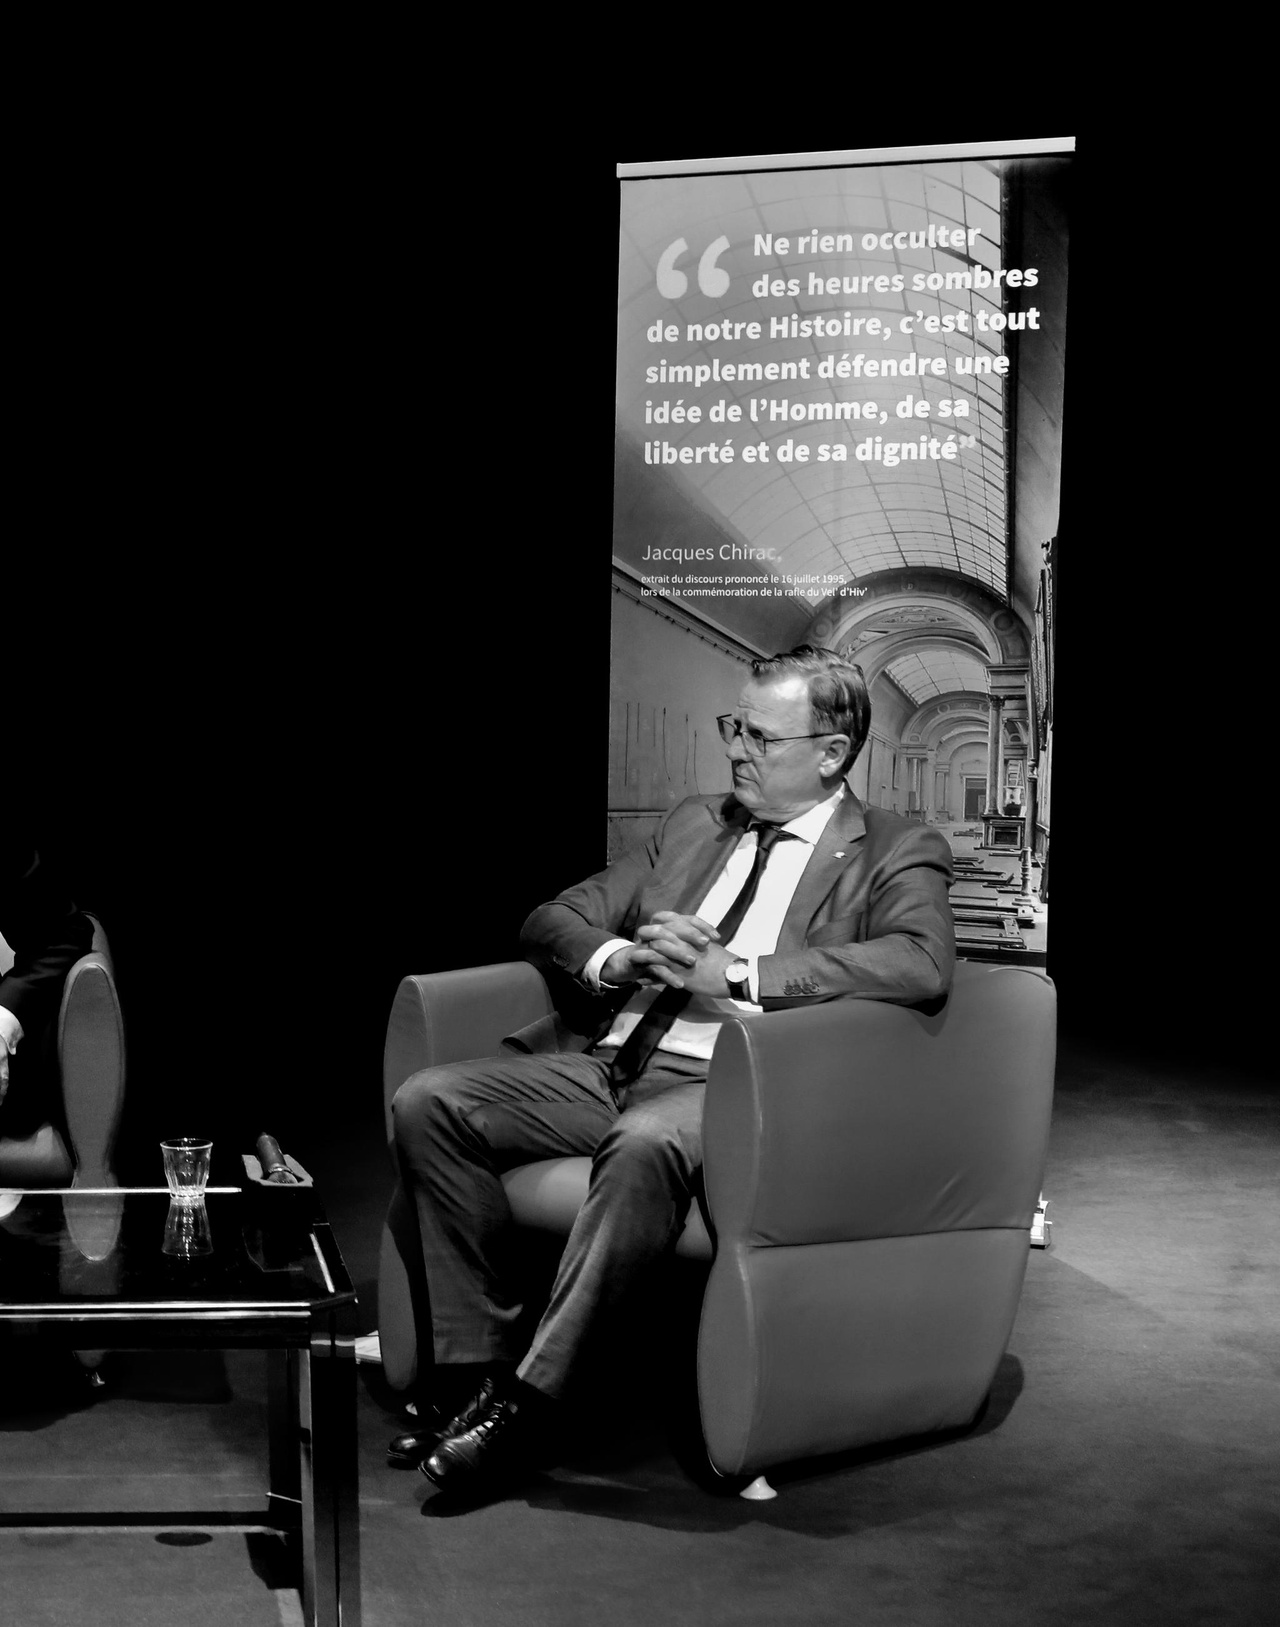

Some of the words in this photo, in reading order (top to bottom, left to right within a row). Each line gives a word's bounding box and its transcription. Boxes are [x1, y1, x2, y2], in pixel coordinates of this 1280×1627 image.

[753, 233, 790, 256] Ne
[797, 229, 853, 254] rien
[861, 224, 981, 251] occulter
[752, 274, 801, 298] des
[807, 271, 905, 296] heures
[911, 265, 1039, 292] sombres
[647, 319, 680, 342] de
[686, 319, 762, 341] notre
[769, 312, 892, 341] Histoire,
[976, 307, 1040, 331] tout
[645, 357, 811, 387] simplement
[817, 352, 947, 379] défendre
[955, 355, 1010, 375] une
[645, 400, 701, 424] idée
[709, 399, 742, 424] de
[895, 395, 931, 419] de
[937, 399, 970, 418] sa
[644, 438, 735, 464] liberté
[742, 442, 769, 464] et
[776, 439, 810, 463] de
[817, 443, 848, 462] sa
[641, 545, 715, 564] Jacques
[641, 575, 670, 584] extrait
[671, 575, 684, 584] du
[685, 575, 723, 584] discours
[724, 574, 769, 586] prononcé
[770, 574, 780, 584] le
[781, 575, 793, 584] 16
[793, 574, 821, 586] juillet
[823, 574, 847, 585] 1995,
[641, 587, 658, 597] lors
[659, 587, 671, 597] de
[672, 587, 681, 597] la
[682, 587, 759, 597] commémoration
[760, 587, 772, 597] de
[774, 587, 783, 597] la
[784, 587, 805, 597] rafle
[807, 587, 820, 597] du
